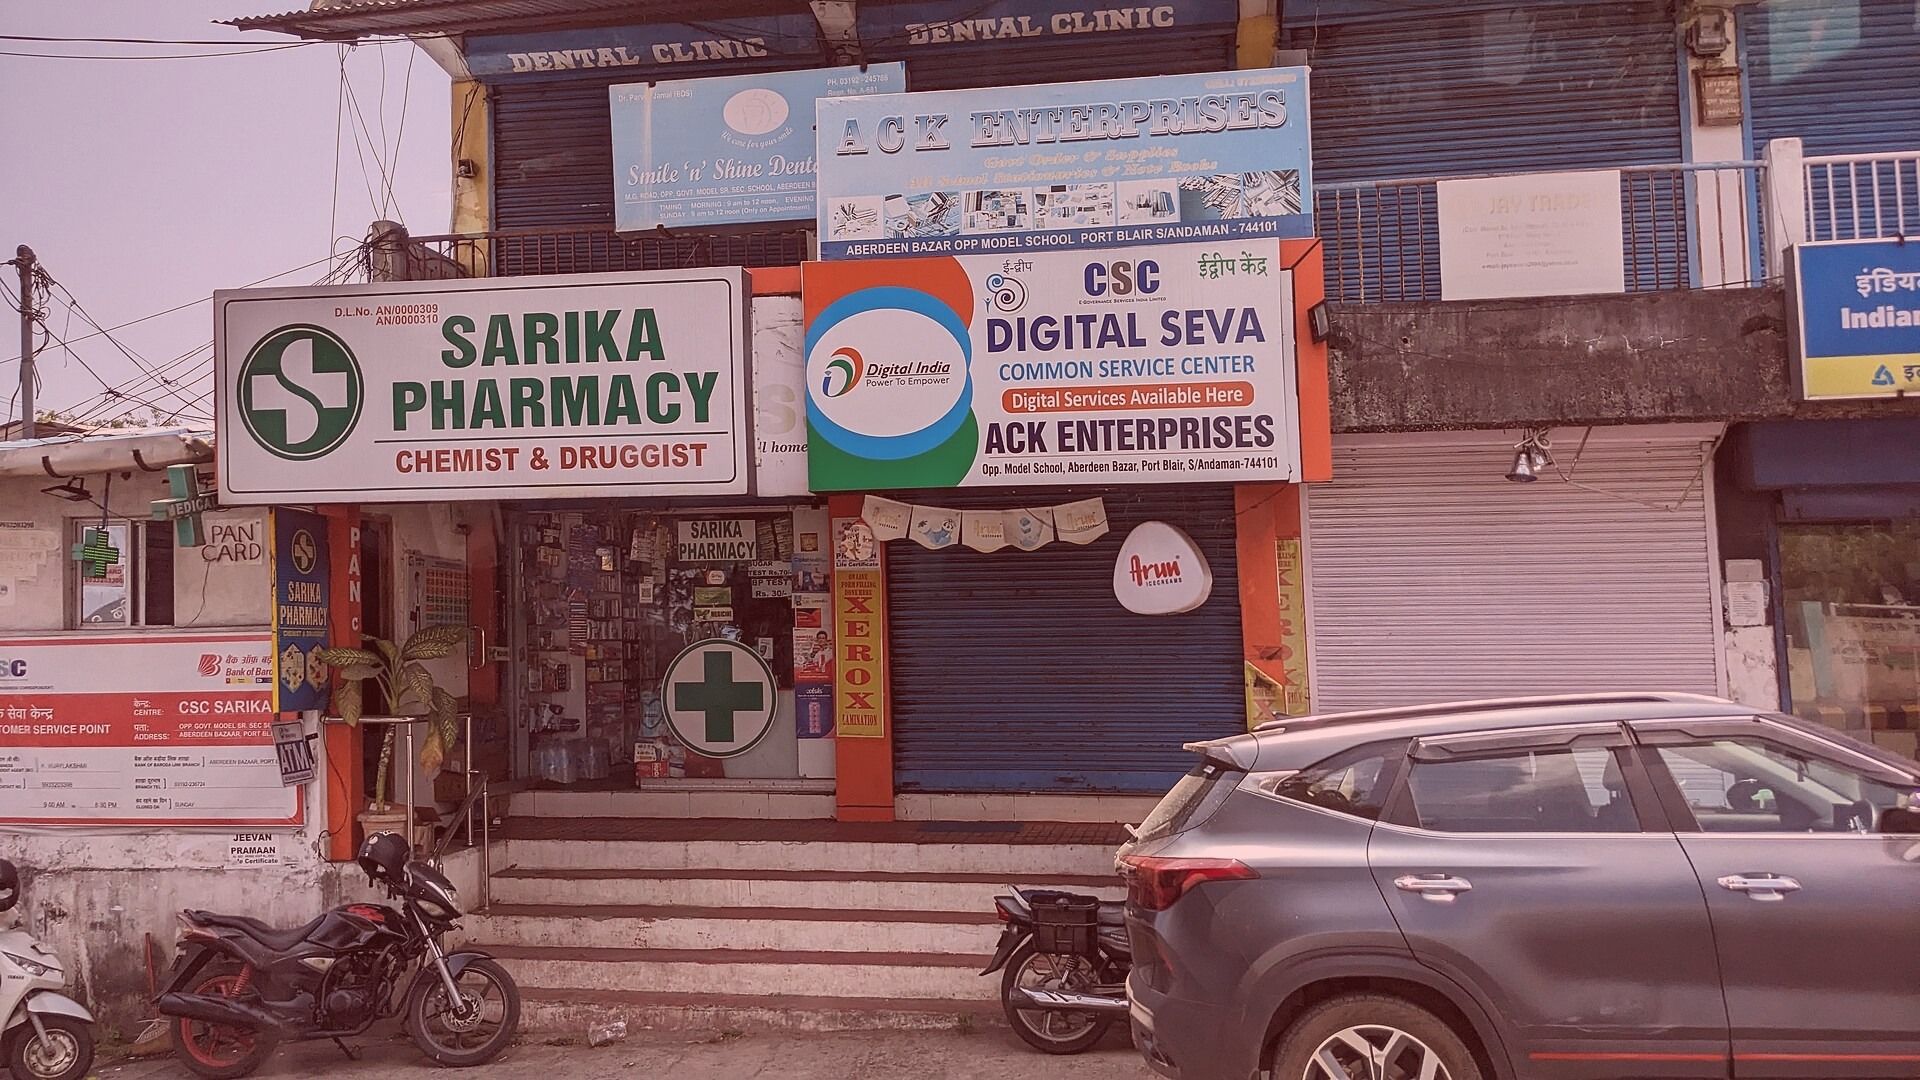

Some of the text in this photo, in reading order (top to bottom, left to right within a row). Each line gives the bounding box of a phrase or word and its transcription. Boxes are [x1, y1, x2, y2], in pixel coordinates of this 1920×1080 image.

[905, 6, 1174, 45] DENTAL CLINIC
[508, 37, 767, 73] DENTAL CLINIC
[970, 89, 1288, 149] ENTERPRISES
[1029, 154, 1080, 167] Order
[1104, 146, 1179, 164] Supplies
[627, 162, 680, 186] Smile
[713, 157, 763, 180] Shine
[907, 176, 933, 189] All
[938, 173, 988, 188] School
[1124, 162, 1163, 176] Note
[1168, 159, 1218, 174] Books
[696, 187, 718, 196] MODEL
[777, 181, 811, 190] ABERDEEN
[659, 211, 686, 219] SUNDAY
[715, 208, 723, 216] 12
[741, 207, 758, 216] (Only
[769, 204, 811, 214] Appointment)
[690, 201, 722, 209] MORNING
[751, 198, 759, 206] 12
[785, 195, 814, 203] EVENING
[846, 221, 1278, 256] ABERDEEN BAZAR OPP MODEL SCHOOL PORT BLAIR S/ANDAMAN 744101
[1084, 259, 1160, 297] CSC
[334, 304, 438, 317] D.L.No. AN/0000309
[375, 314, 438, 326] AN/0000310
[441, 308, 666, 369] SARIKA
[986, 307, 1265, 353] DIGITAL SEVA
[867, 361, 951, 379] Digital India
[999, 355, 1255, 381] COMMON SERVICE CENTER
[866, 377, 949, 387] Power To Empower
[392, 371, 720, 432] PHARMACY
[1012, 386, 1243, 412] Digital Services Available Here
[984, 414, 1275, 454] ACK ENTERPRISES
[771, 441, 808, 453] home
[395, 443, 708, 474] CHEMIST & DRUGGIST
[982, 457, 1278, 477] Opp. Model School, Aberdeen Bazar, Port Blair, S/Andaman-744101
[211, 523, 254, 544] PAN
[690, 520, 743, 539] SARIKA
[201, 543, 261, 562] CARD
[679, 541, 755, 560] PHARMACY
[1129, 554, 1181, 587] Arun
[288, 580, 322, 604] SARIKA
[1146, 577, 1182, 587] ICECREAMS
[280, 605, 327, 627] PHARMACY
[225, 667, 245, 676] Bank
[246, 667, 254, 676] of
[7, 704, 27, 720] सेवा
[178, 700, 210, 714] CSC
[214, 700, 272, 713] SARIKA
[33, 724, 111, 734] SERVICE POINT
[842, 714, 878, 726] LAMINATION
[277, 741, 312, 774] ATM
[233, 834, 272, 842] JEEVAN
[230, 846, 276, 855] PRAMAAN
